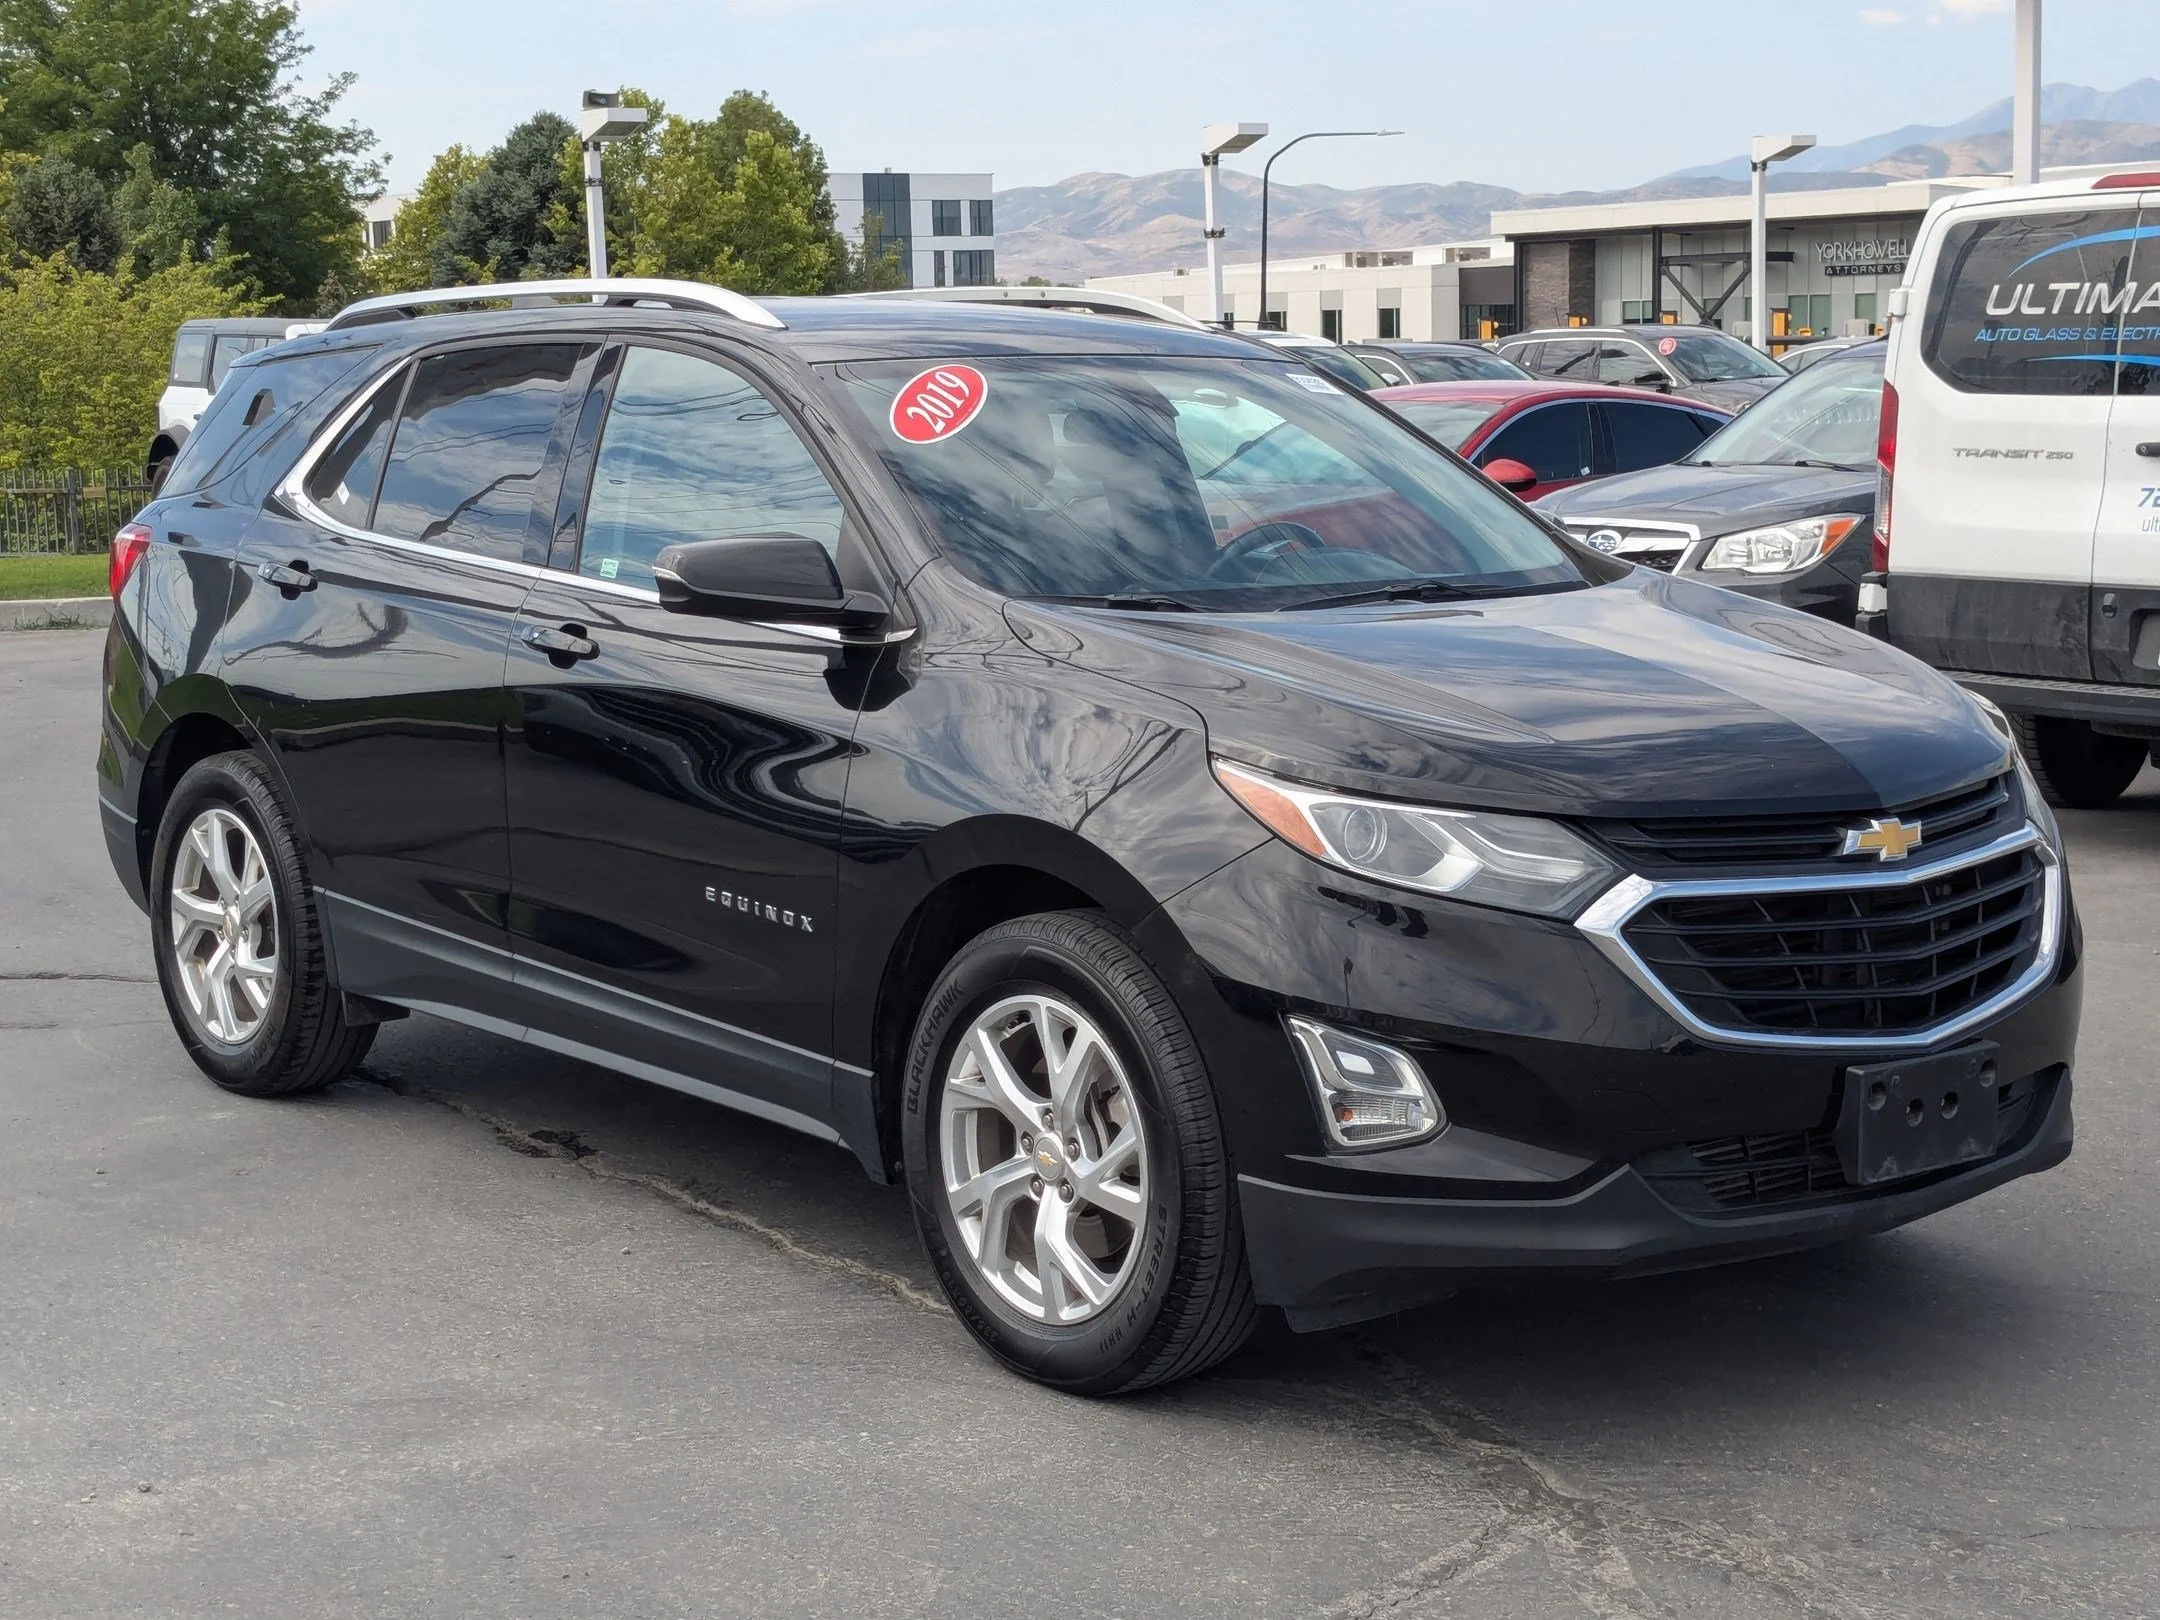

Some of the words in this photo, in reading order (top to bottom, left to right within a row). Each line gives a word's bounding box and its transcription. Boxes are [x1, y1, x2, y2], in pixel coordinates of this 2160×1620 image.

[1826, 264, 1901, 275] ATTORNEYS
[1975, 327, 2021, 342] AUTO
[2023, 327, 2080, 341] GLASS
[2083, 327, 2097, 340] &
[906, 371, 970, 434] 2019
[1953, 447, 2045, 459] TRANSIT
[2045, 450, 2074, 460] 250
[705, 886, 813, 932] EQUINOX
[907, 975, 965, 1116] BLACKHAWK
[1127, 1203, 1168, 1328] STREET-H
